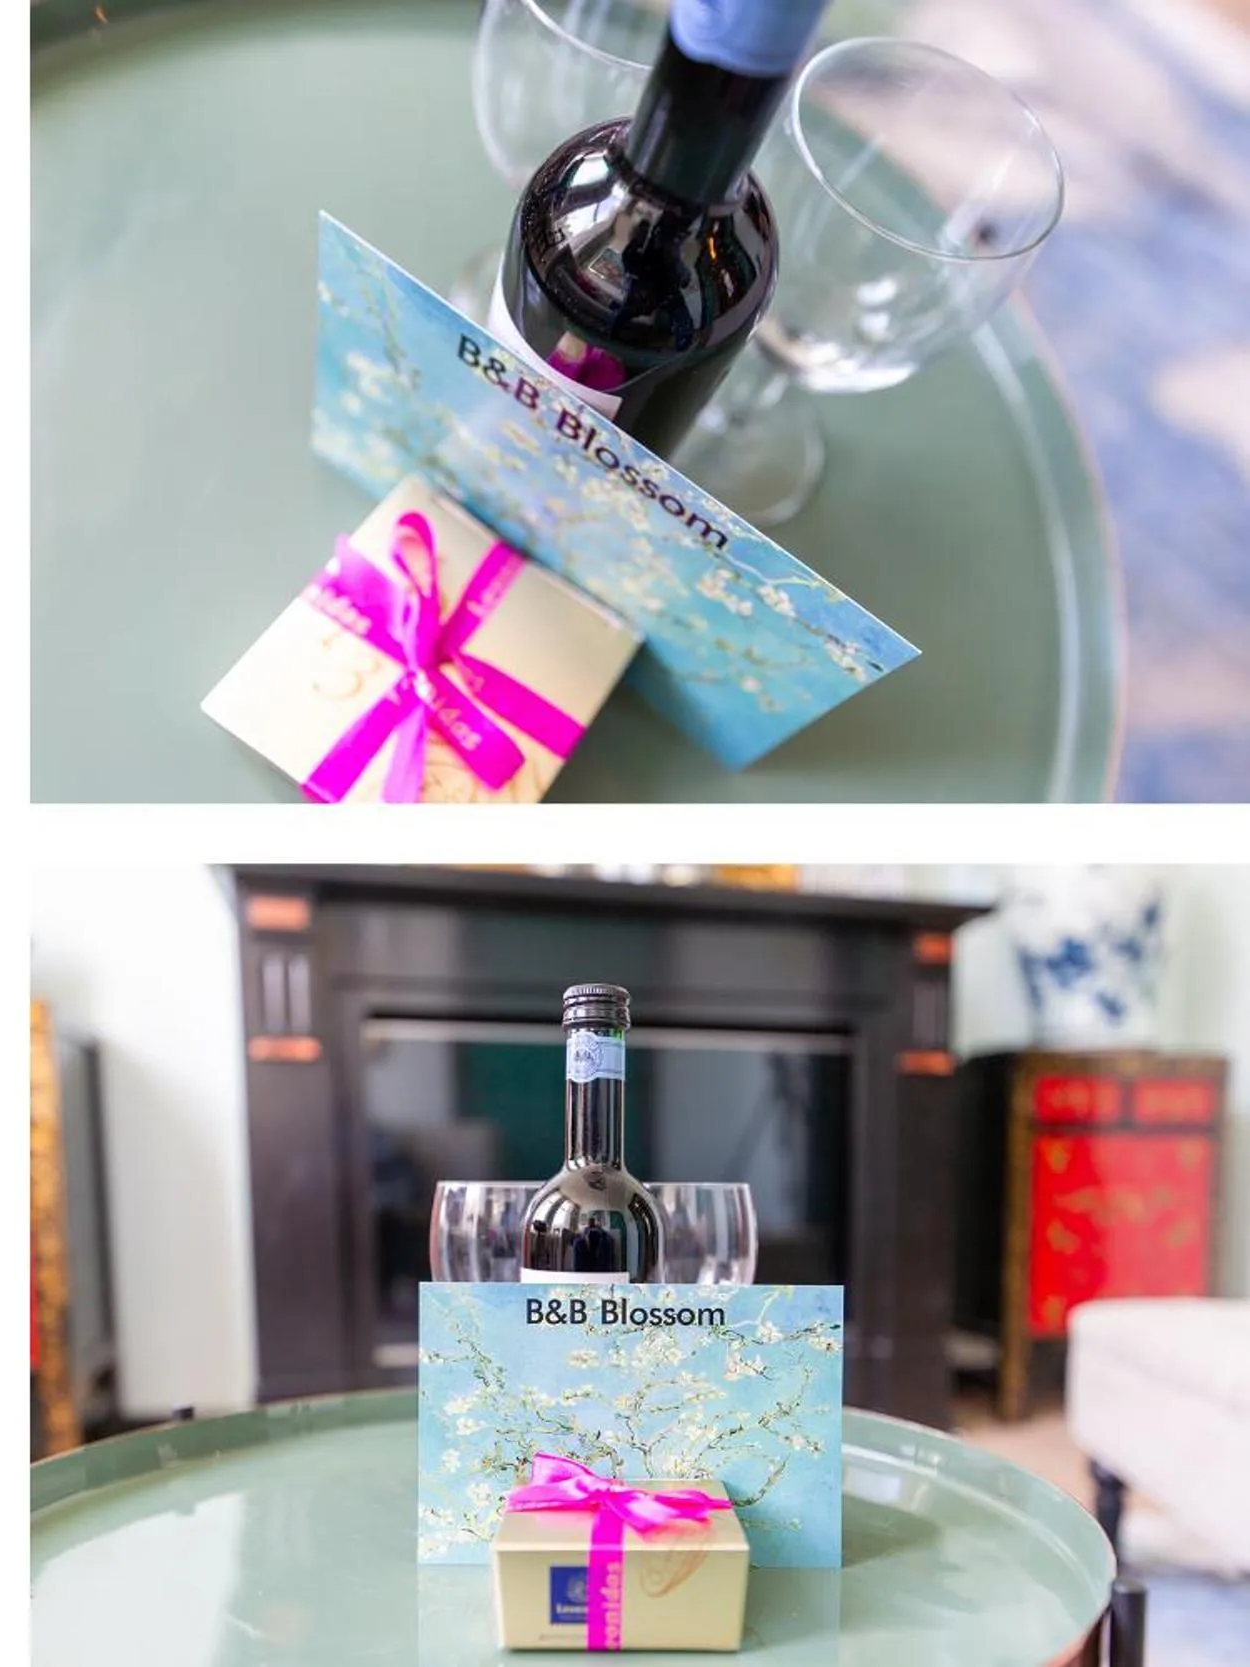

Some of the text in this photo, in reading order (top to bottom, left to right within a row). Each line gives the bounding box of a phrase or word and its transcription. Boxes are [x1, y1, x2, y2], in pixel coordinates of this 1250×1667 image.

[457, 334, 729, 550] B&B Blossom
[526, 1297, 725, 1326] B&B Blossom
[599, 1561, 622, 1650] eonidas
